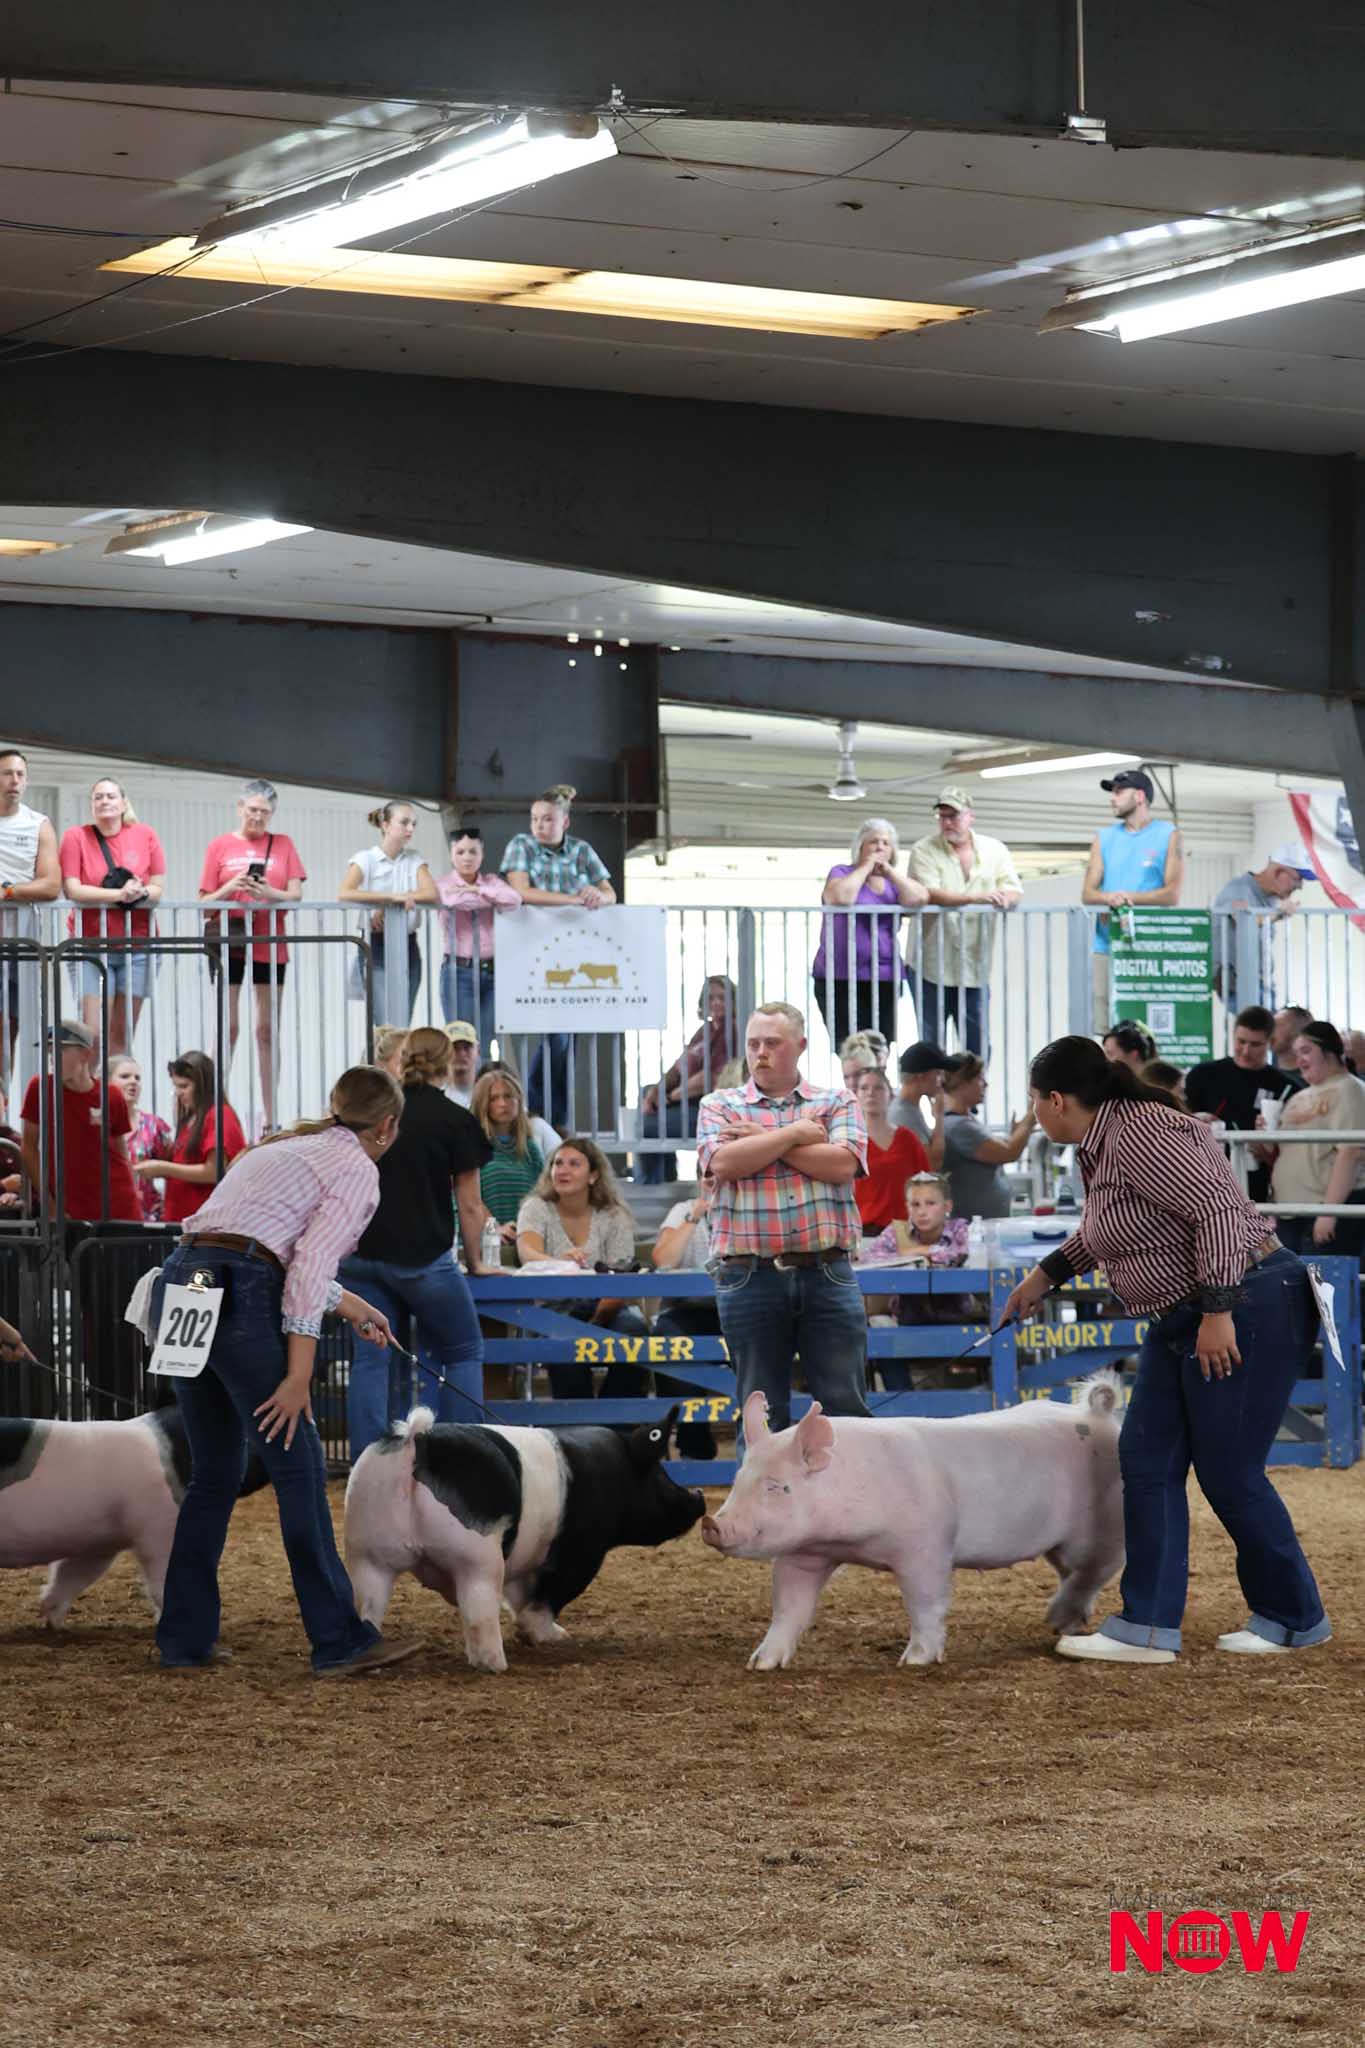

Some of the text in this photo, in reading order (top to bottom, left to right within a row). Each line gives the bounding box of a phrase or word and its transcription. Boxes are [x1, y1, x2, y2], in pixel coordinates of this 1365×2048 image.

[1113, 960, 1208, 977] DIGITAL PHOTOS
[515, 996, 557, 1005] MARION
[561, 996, 601, 1005] COUNTY
[625, 996, 648, 1005] FAIR
[163, 1307, 213, 1348] 202
[1014, 1322, 1114, 1348] MEMORY
[575, 1336, 695, 1363] RIVER
[682, 1396, 741, 1423] FF
